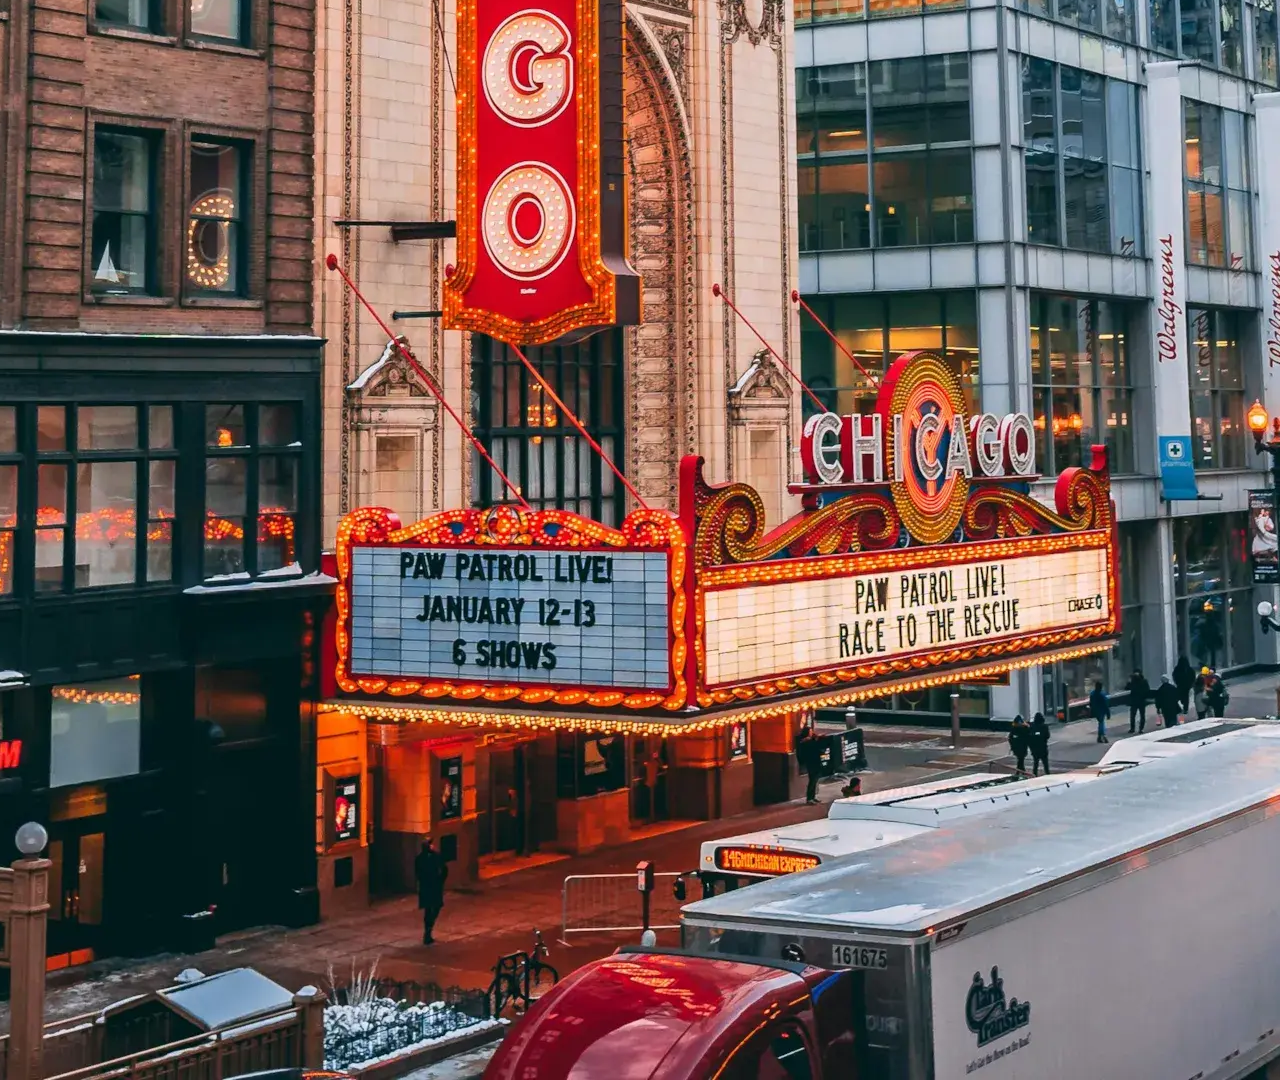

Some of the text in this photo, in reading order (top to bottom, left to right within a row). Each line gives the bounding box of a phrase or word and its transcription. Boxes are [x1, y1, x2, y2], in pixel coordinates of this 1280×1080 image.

[1158, 234, 1182, 363] Walgreens
[812, 411, 1037, 484] CHICAGO
[400, 552, 613, 584] PAW PATROL LIVE!
[855, 564, 1006, 614] PAW PATROL LIVE!
[1068, 596, 1095, 612] CHASE
[416, 595, 596, 627] JANUARY 12-13
[839, 599, 1020, 658] RACE TO THE RESCUE
[452, 638, 557, 670] 6 SHOWS
[835, 945, 888, 969] 161675
